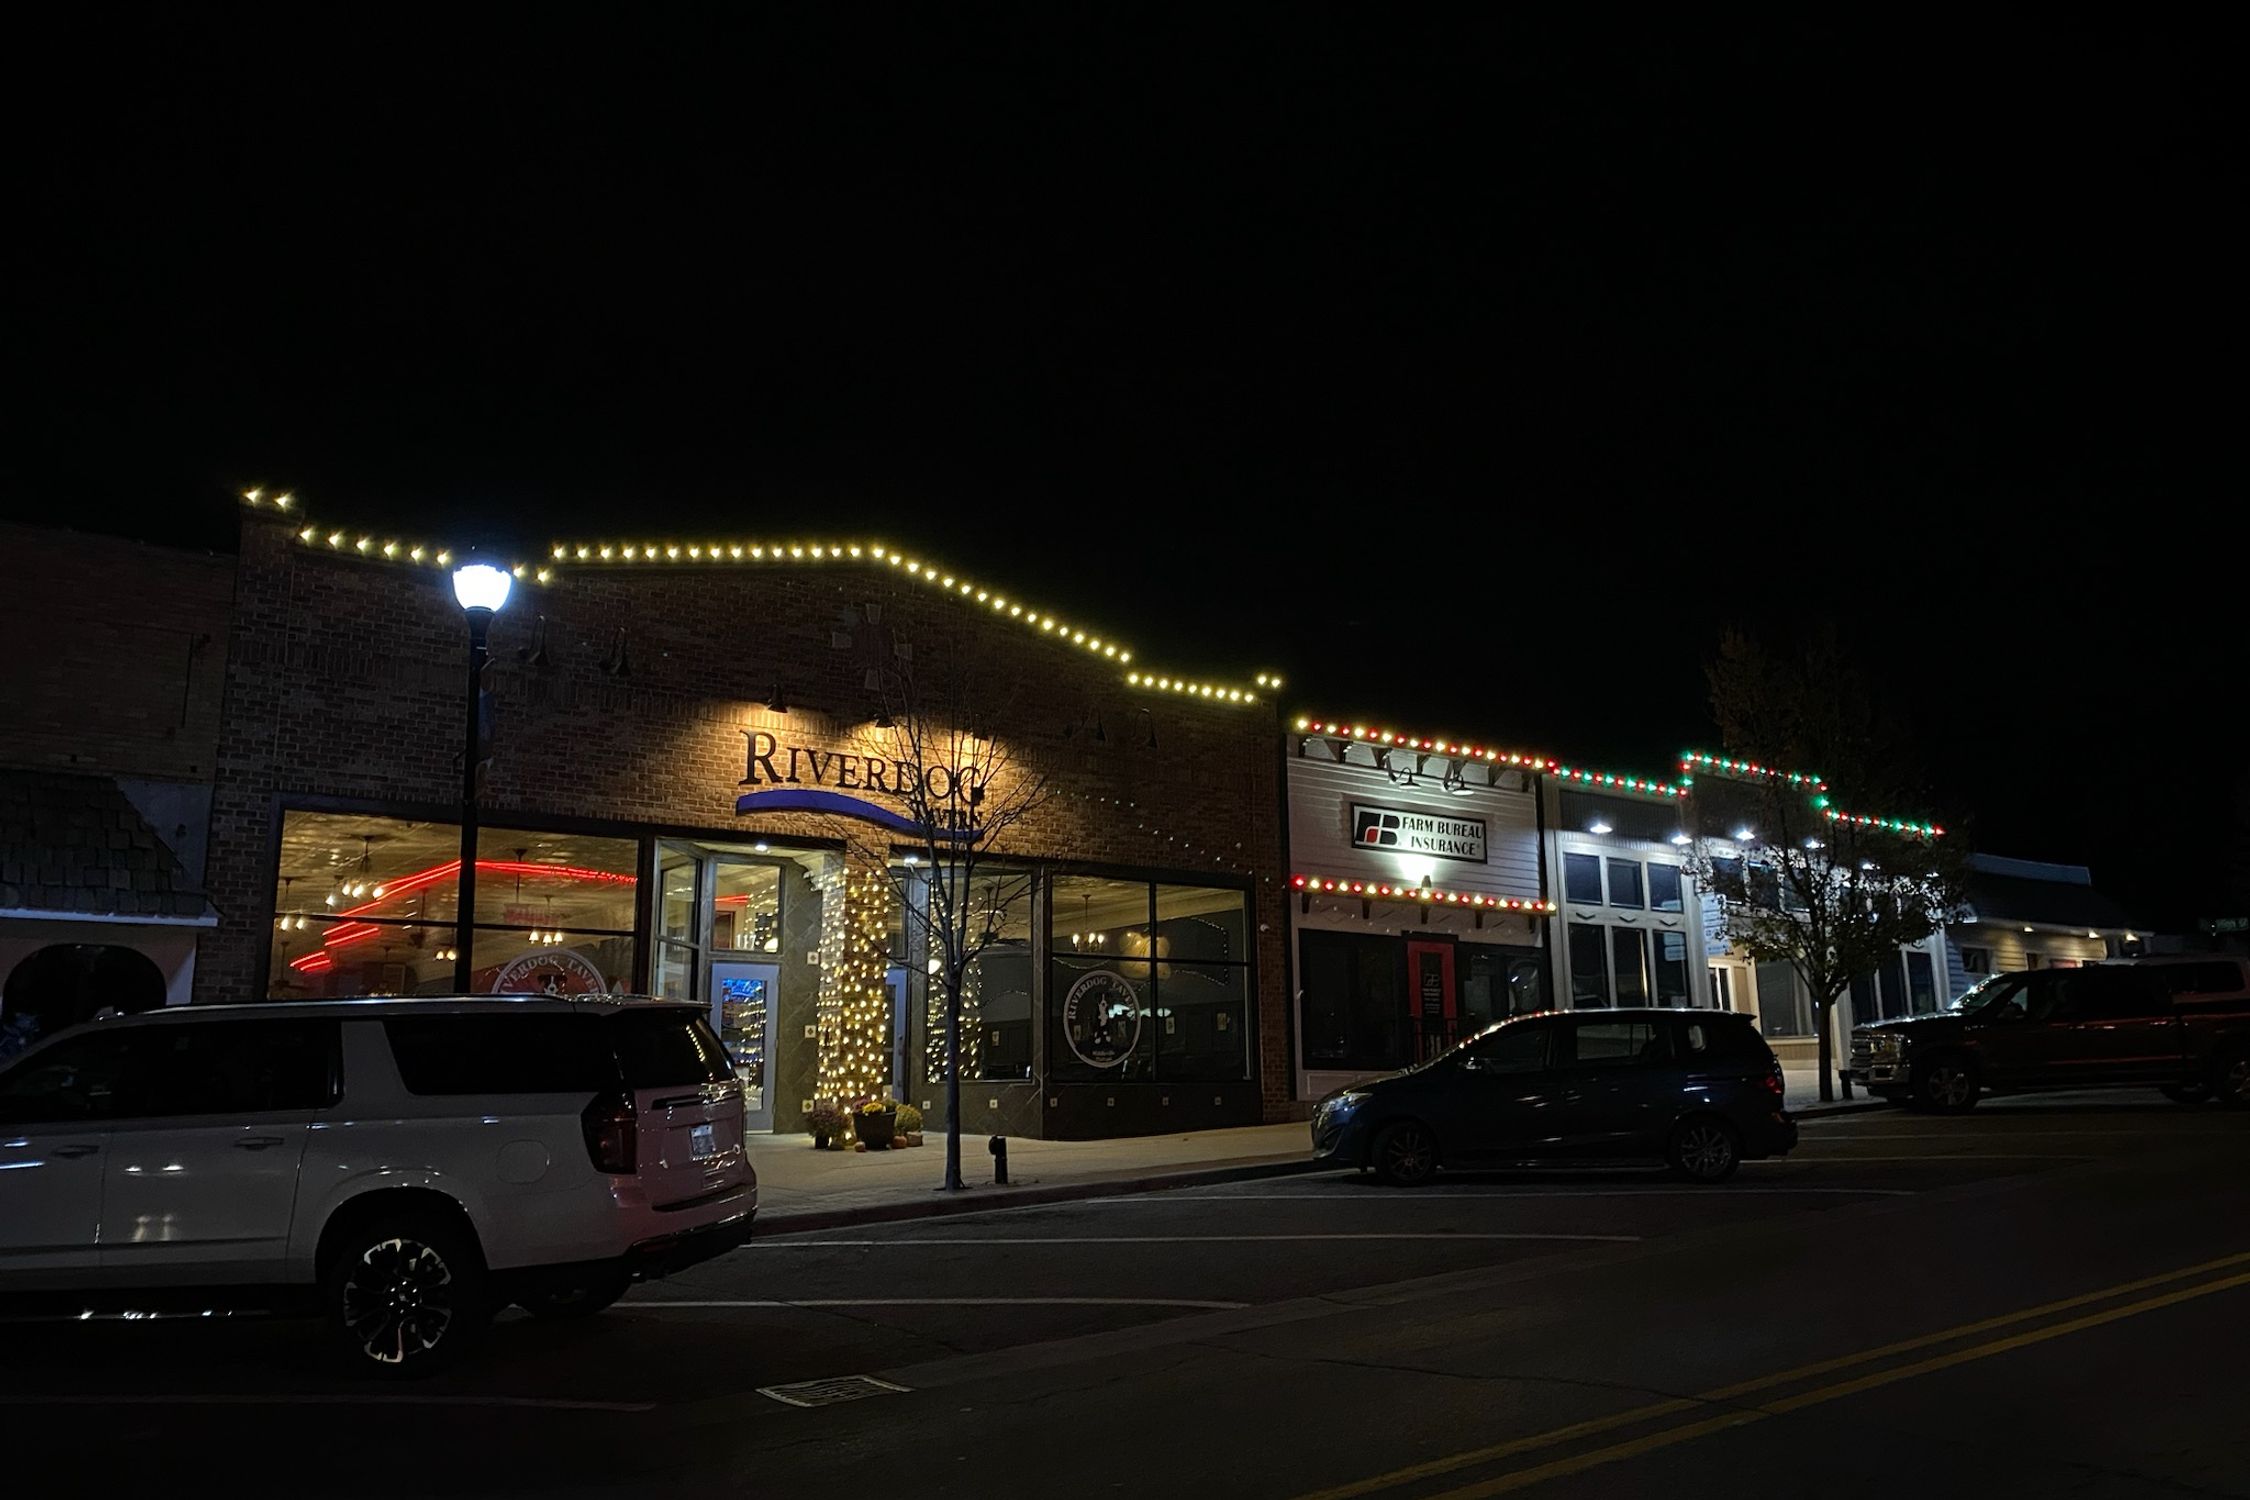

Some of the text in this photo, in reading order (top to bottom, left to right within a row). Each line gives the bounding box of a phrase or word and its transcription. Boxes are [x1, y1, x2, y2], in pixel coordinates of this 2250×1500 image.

[738, 730, 982, 804] RIVERDOG
[914, 805, 984, 830] AVERN
[1402, 816, 1483, 839] FARM BUREAU
[1411, 836, 1477, 855] INSURANCE
[499, 955, 600, 994] IVERDOG TAVE
[1067, 976, 1107, 1020] RIVERDOG
